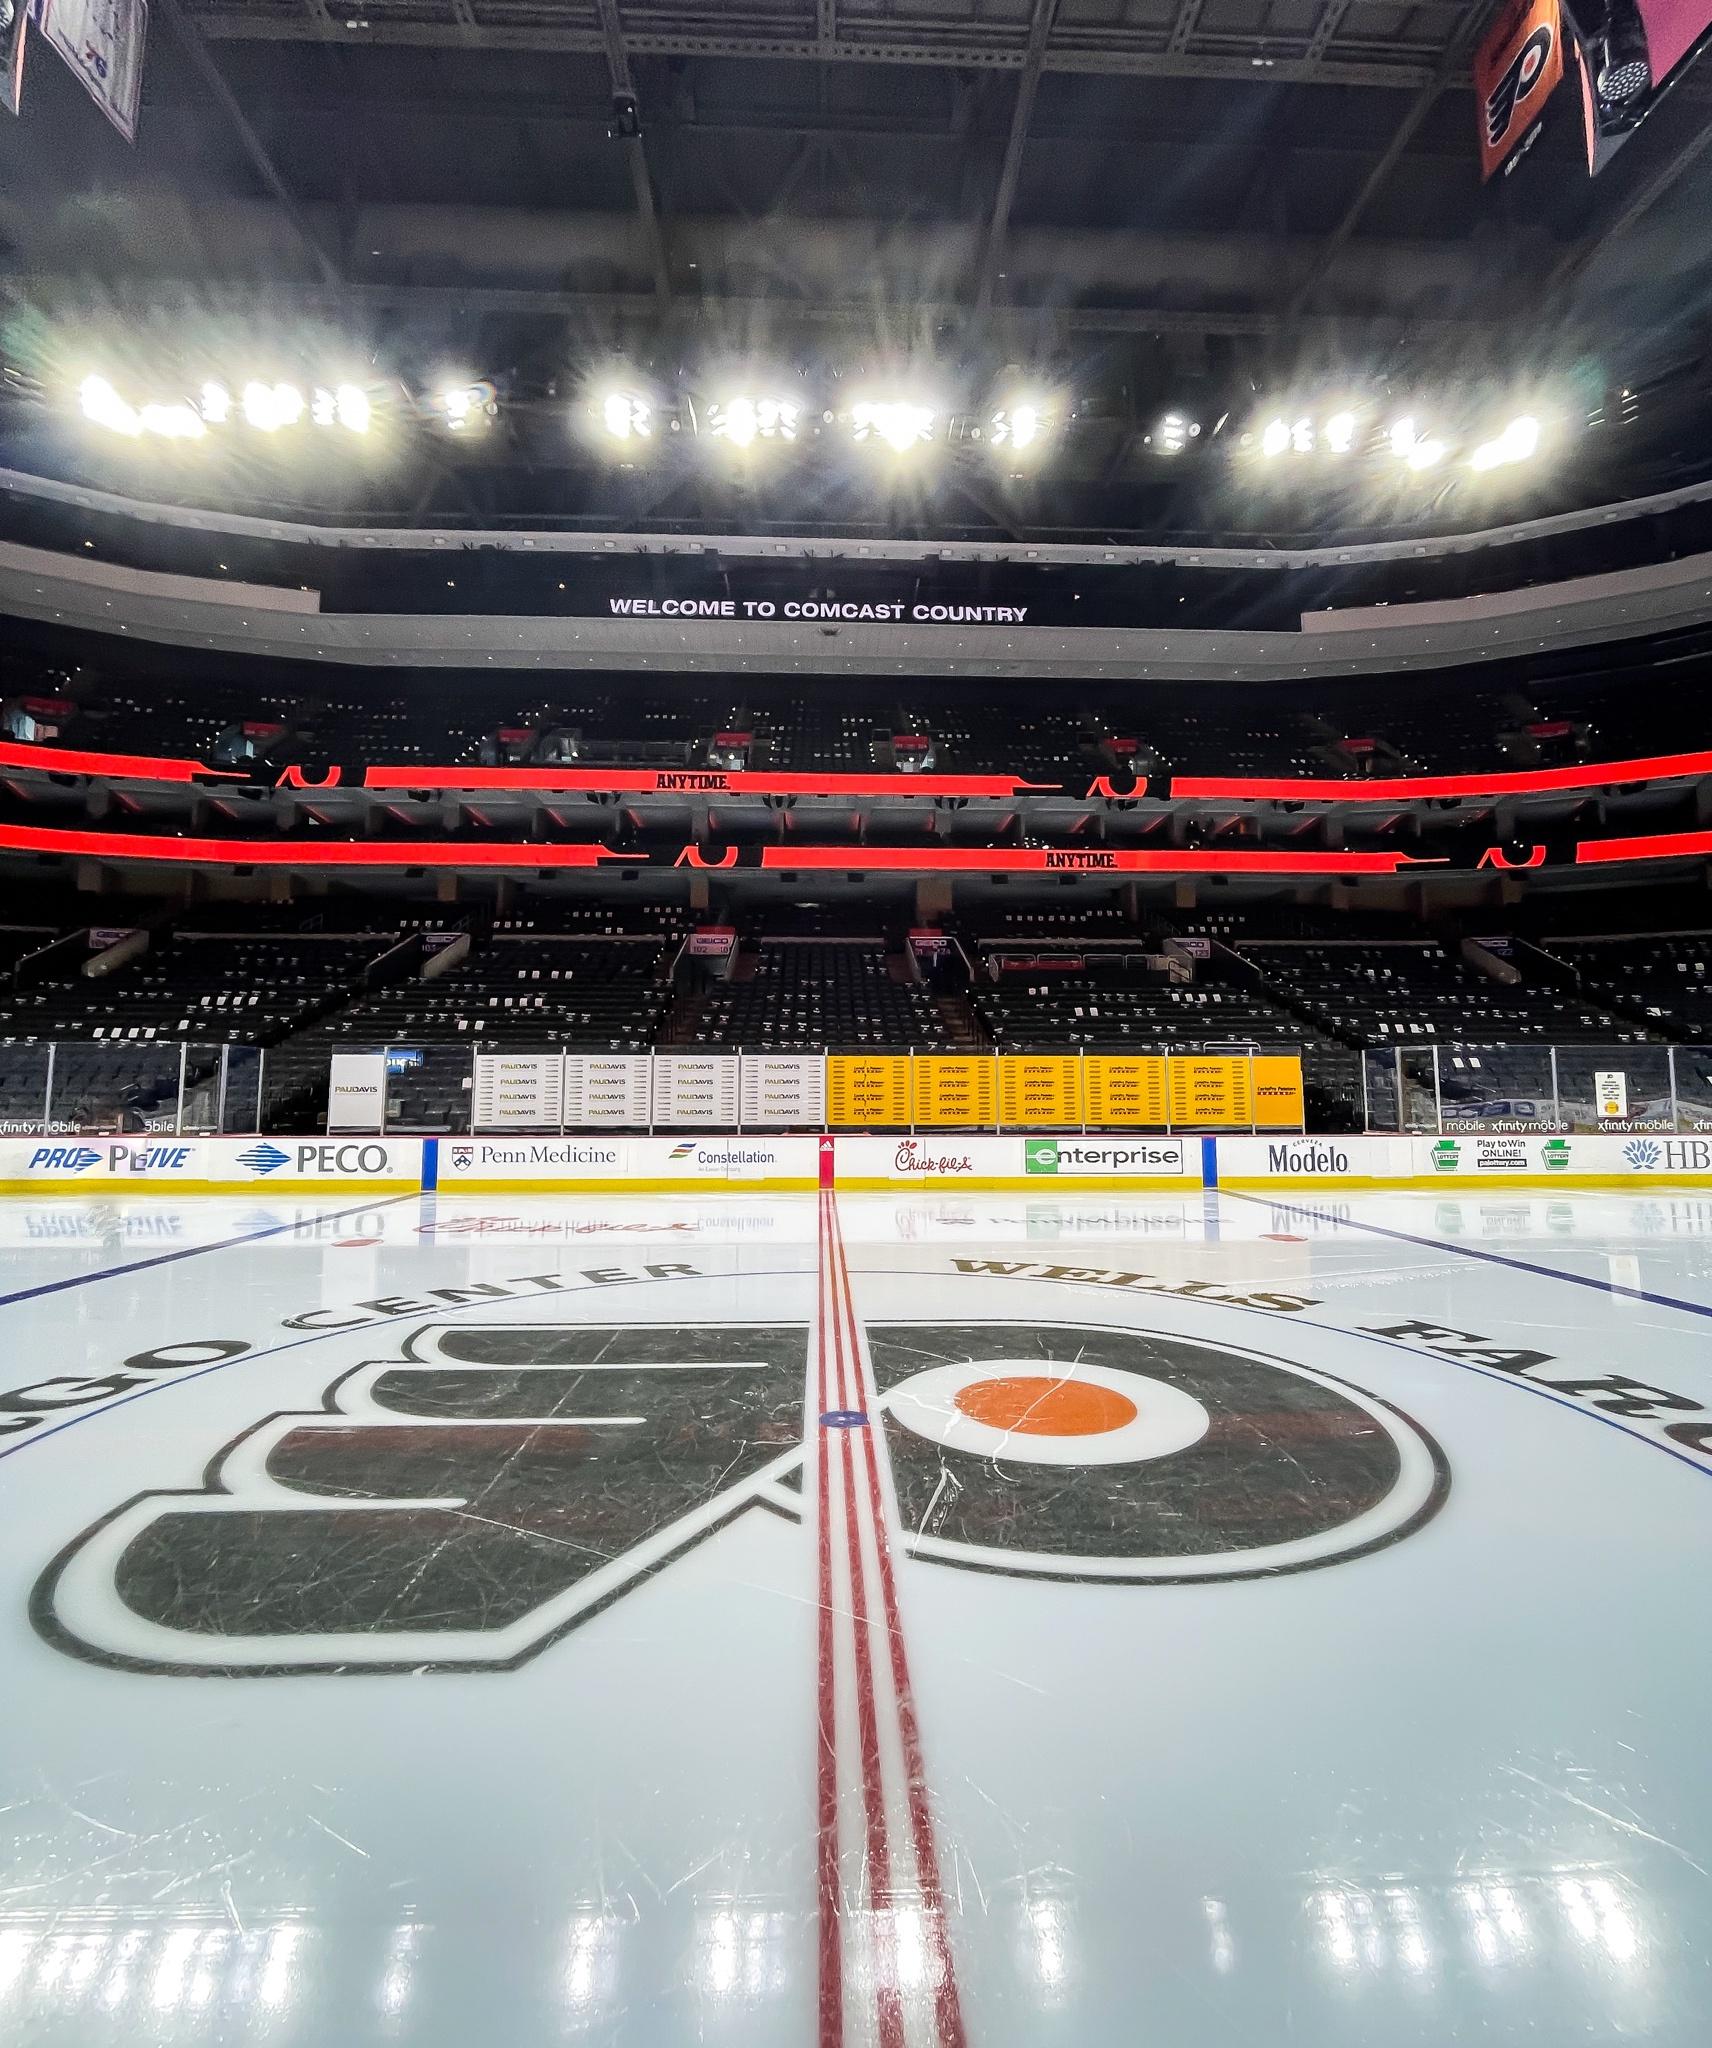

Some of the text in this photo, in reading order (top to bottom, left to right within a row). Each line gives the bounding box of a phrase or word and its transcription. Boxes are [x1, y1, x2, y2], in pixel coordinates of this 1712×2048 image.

[610, 598, 1027, 622] WELCOME TO COMCAST COUNTRY
[1446, 1120, 1485, 1133] mobile
[1491, 1120, 1526, 1133] xfinity
[1597, 1119, 1674, 1132] xfinity mobile
[1477, 1140, 1496, 1149] Play
[1509, 1139, 1526, 1147] Win
[1482, 1149, 1522, 1157] ONLINE!
[297, 1145, 388, 1173] PECO
[481, 1145, 616, 1163] Penn Medicine
[698, 1151, 775, 1164] Constellation
[1034, 1147, 1179, 1168] enterprise
[1269, 1145, 1348, 1173] Modelo
[1663, 1141, 1712, 1169] HB
[950, 1259, 1324, 1312] WELLS
[281, 1263, 704, 1330] CENTER
